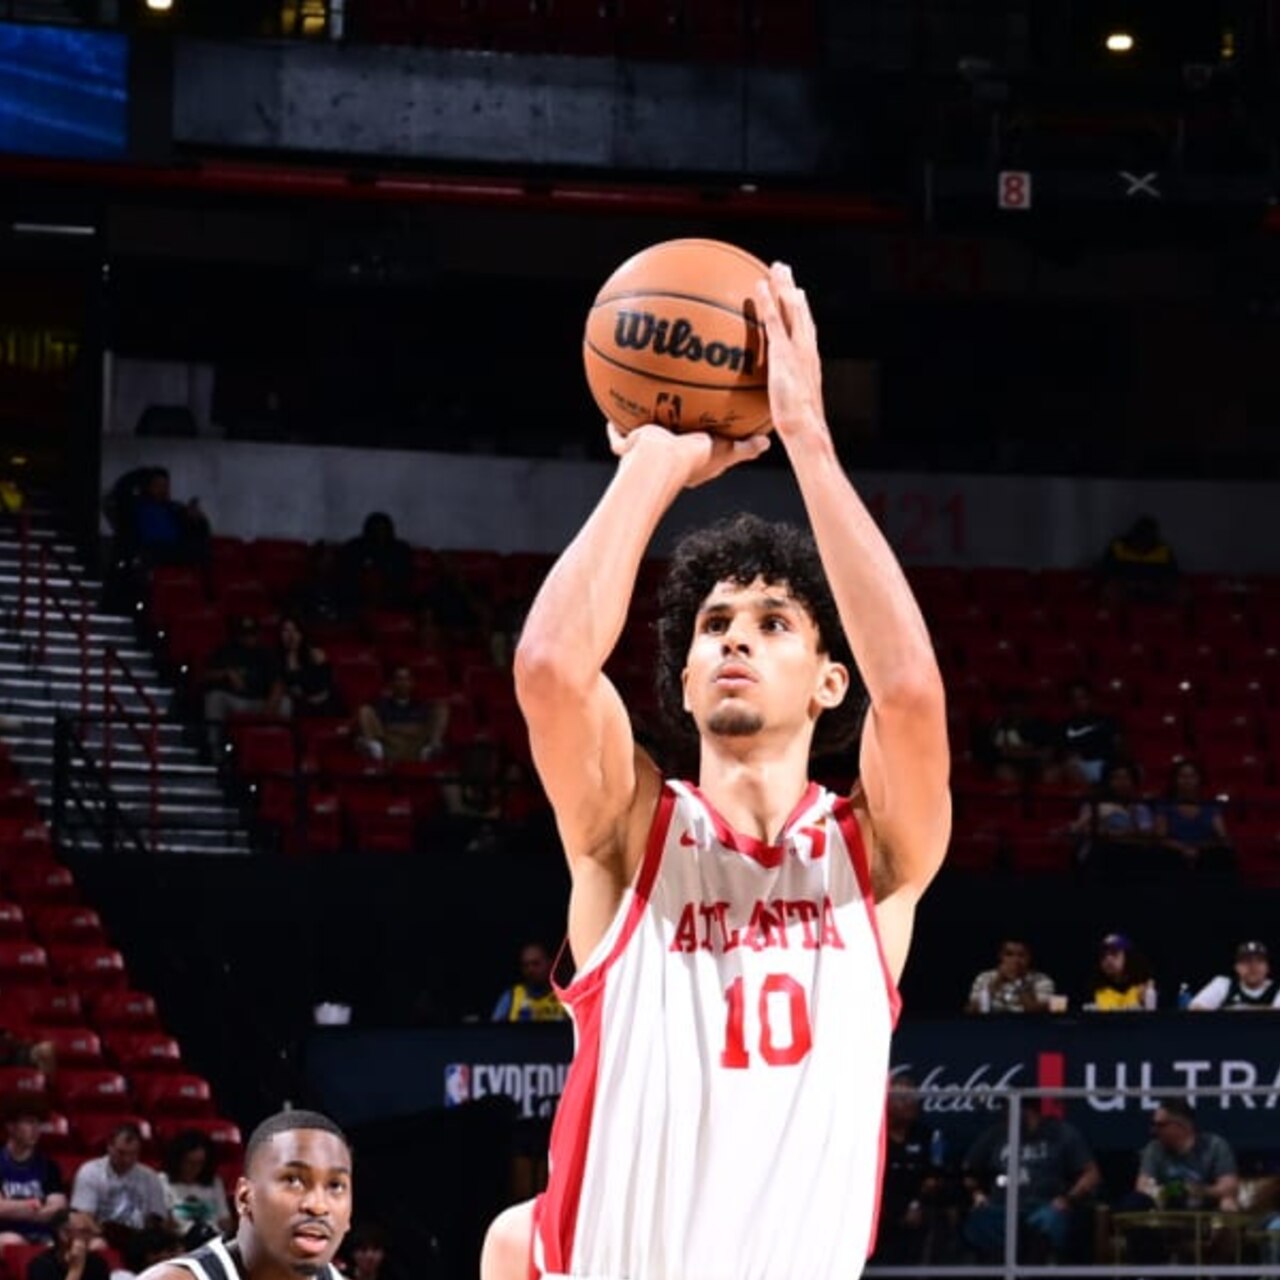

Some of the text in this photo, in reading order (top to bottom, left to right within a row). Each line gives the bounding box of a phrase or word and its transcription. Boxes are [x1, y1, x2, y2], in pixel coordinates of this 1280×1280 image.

[1004, 174, 1026, 206] 8
[615, 310, 754, 376] Wilson
[669, 895, 846, 953] ATLANTA
[720, 972, 813, 1069] 10
